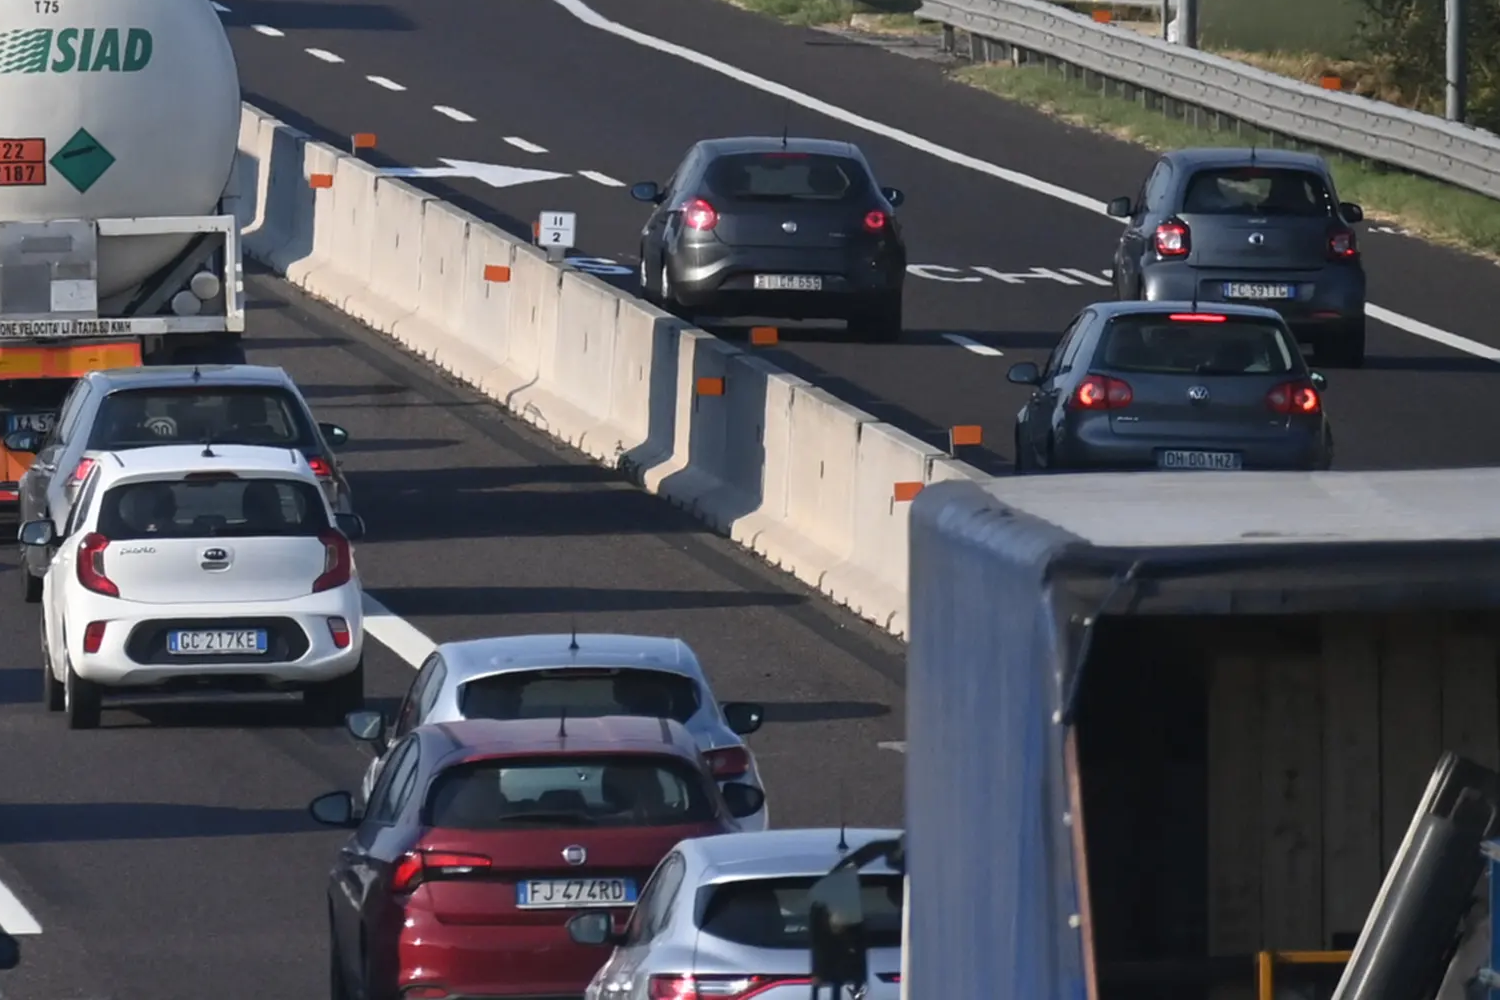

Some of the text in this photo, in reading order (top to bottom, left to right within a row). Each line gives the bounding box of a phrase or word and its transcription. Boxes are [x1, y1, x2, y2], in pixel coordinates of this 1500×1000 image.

[51, 28, 153, 73] SIAD
[2, 143, 25, 159] 22
[552, 232, 561, 243] 2
[180, 631, 255, 649] GC 217KE
[530, 880, 623, 901] FJ 474RD
